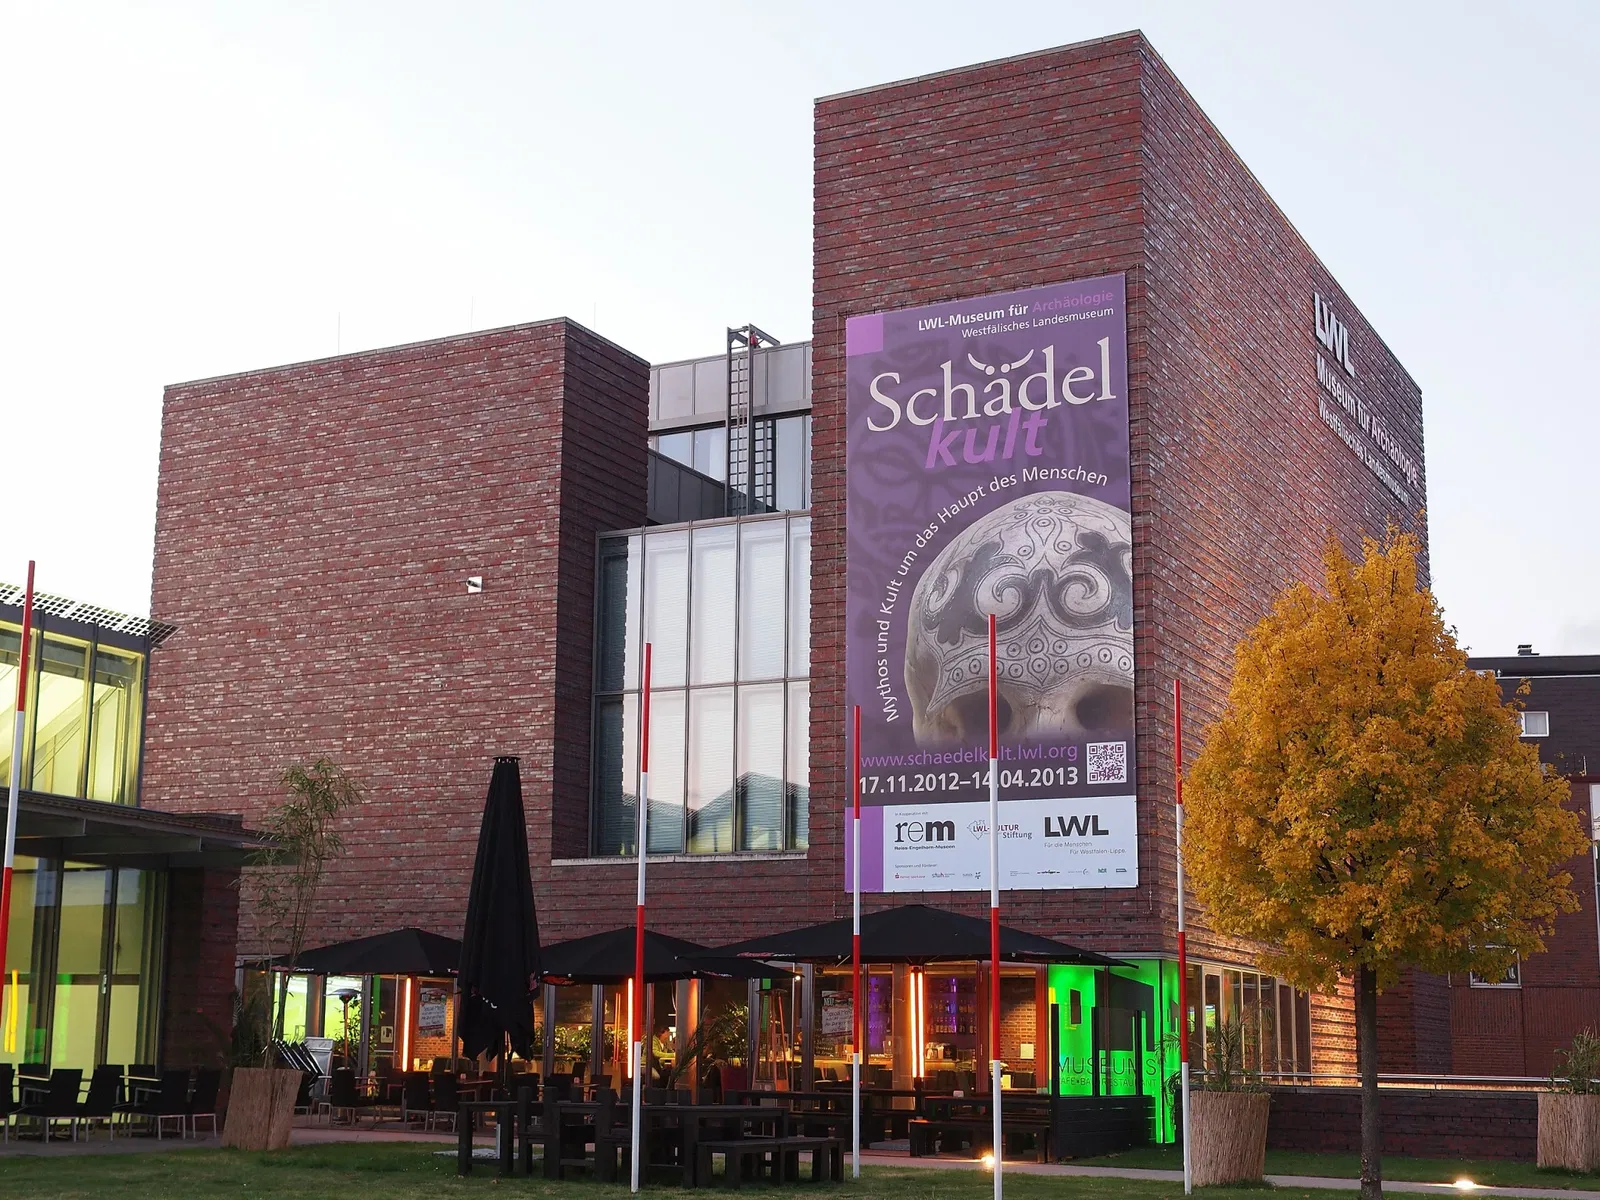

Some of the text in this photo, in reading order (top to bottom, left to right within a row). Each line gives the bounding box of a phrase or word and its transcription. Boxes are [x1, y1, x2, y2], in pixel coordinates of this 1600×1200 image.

[918, 290, 1114, 332] LWL-Museum für Archäologie
[961, 307, 1114, 339] Westfälisches Landesmuseum
[1314, 291, 1355, 378] LWL
[866, 336, 1117, 432] Schädel
[925, 407, 1048, 469] kult
[1316, 352, 1418, 487] Museum für Archäologie
[1364, 446, 1409, 506] Landesmuseum
[876, 465, 1109, 723] Mythos und Kult um das Haupt des Menschen
[861, 743, 1078, 769] www.schaedelklt.lwl.org
[894, 820, 955, 843] rem
[1002, 831, 1033, 840] Stiftung
[1044, 814, 1110, 838] LWL
